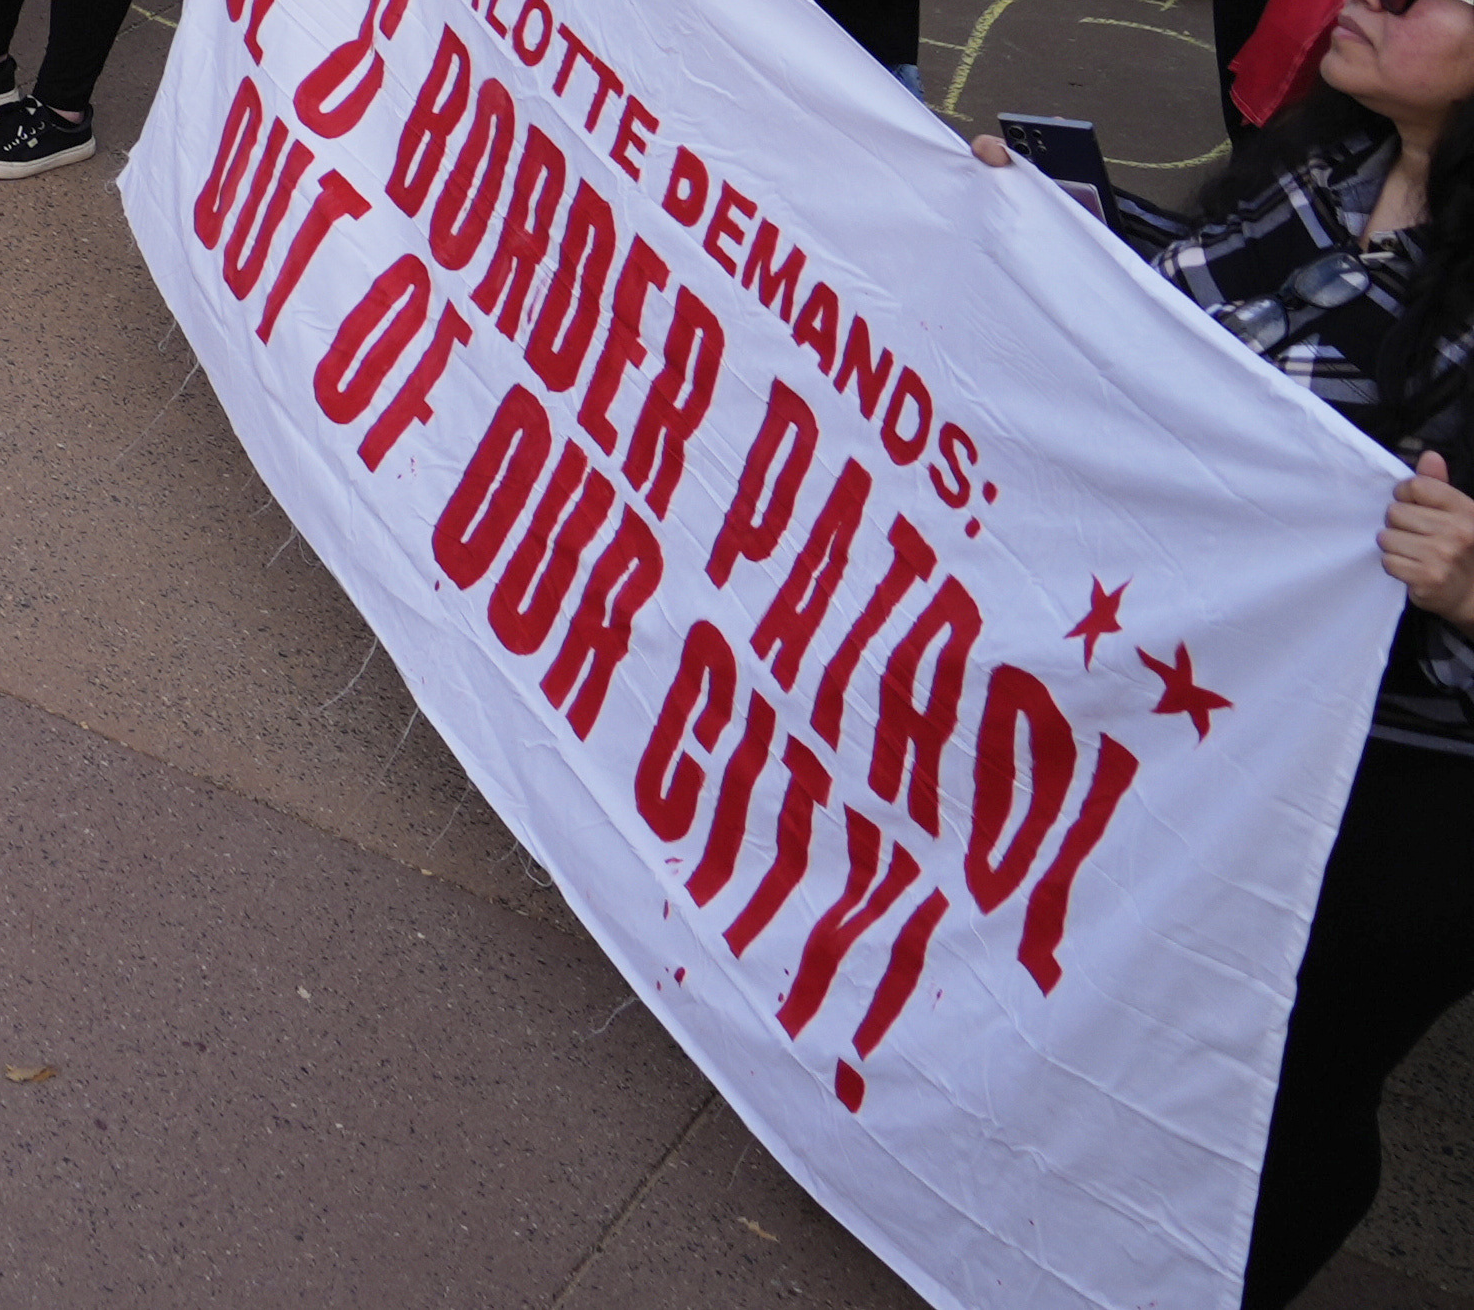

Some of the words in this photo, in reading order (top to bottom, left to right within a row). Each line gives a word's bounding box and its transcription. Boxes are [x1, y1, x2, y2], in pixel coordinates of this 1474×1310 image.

[194, 76, 371, 346] OUT
[312, 253, 474, 473] OF
[432, 382, 663, 743] OUR
[635, 618, 949, 1113] CITY!
[386, 23, 725, 521] BORDER
[705, 376, 1139, 997] PATROL
[662, 144, 998, 539] DEMANDS:
